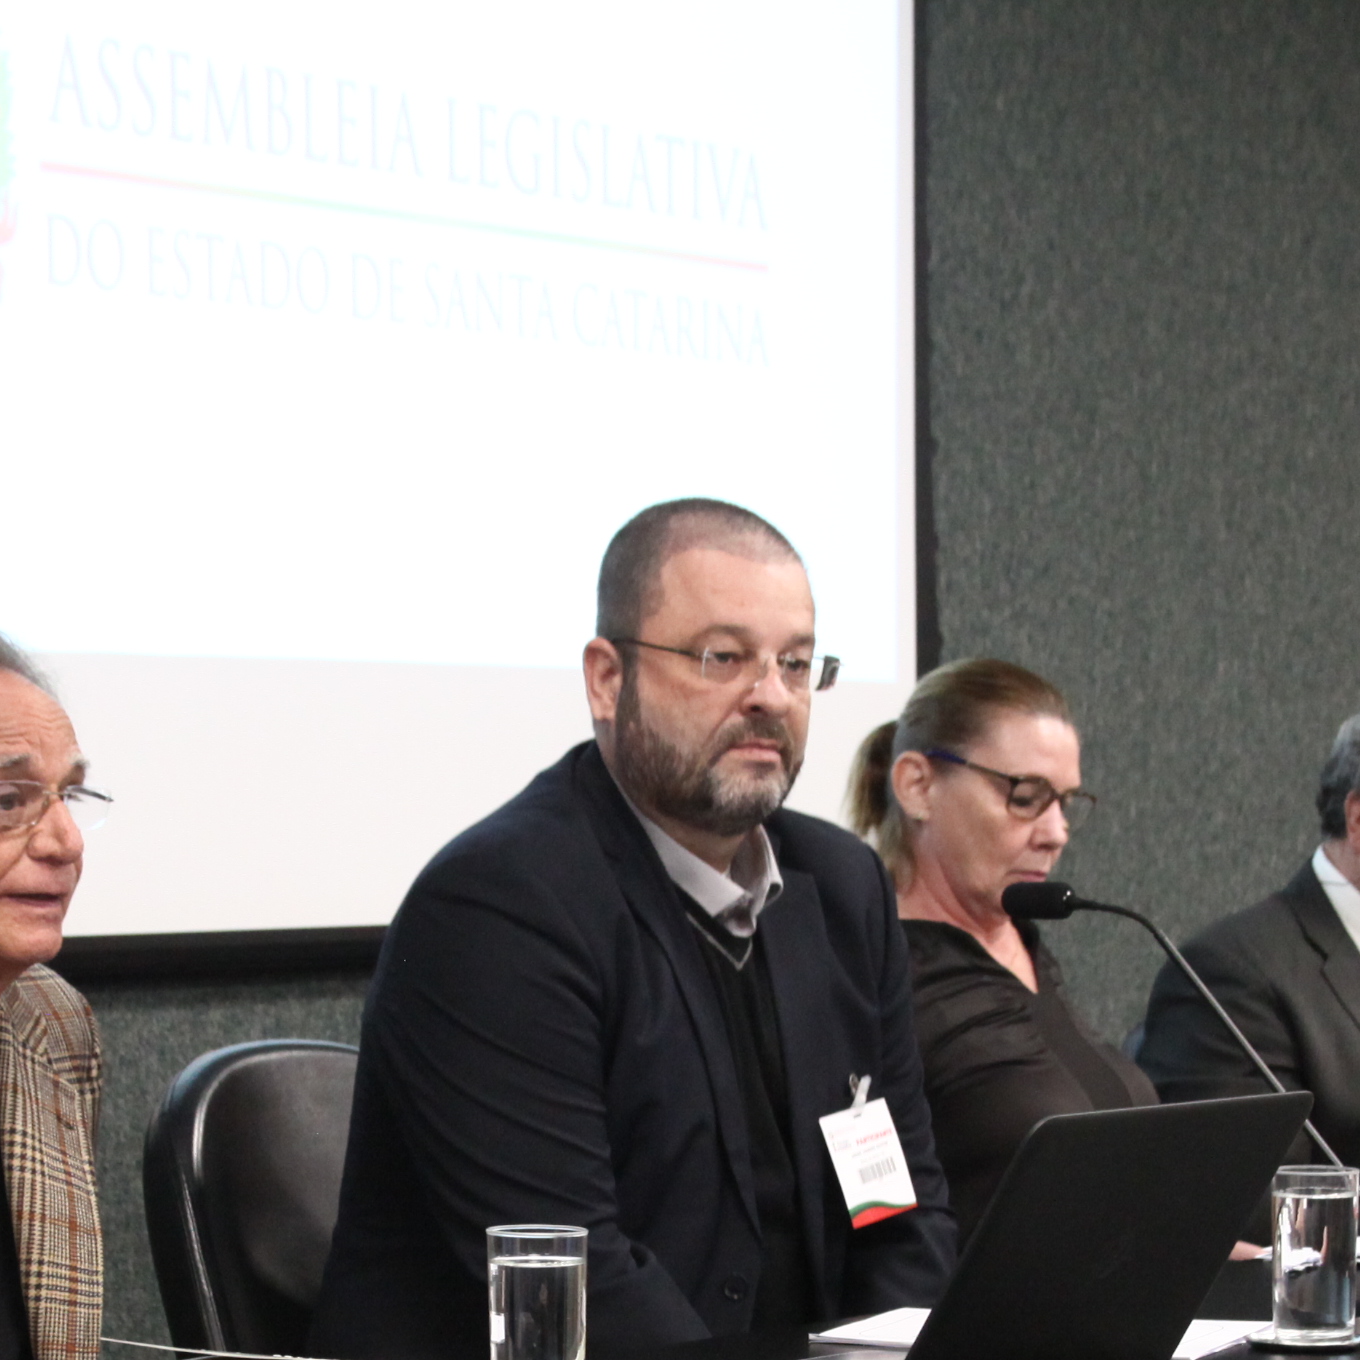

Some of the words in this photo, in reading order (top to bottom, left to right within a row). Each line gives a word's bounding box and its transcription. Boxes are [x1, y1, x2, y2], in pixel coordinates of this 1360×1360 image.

[48, 31, 427, 180] ASSEMBLEIA
[445, 94, 770, 233] LEGISLATIVA
[46, 213, 126, 292] DO
[147, 225, 332, 315] ESTADO
[351, 252, 409, 325] DE
[423, 260, 561, 343] SANTA
[571, 281, 772, 368] CATARINA
